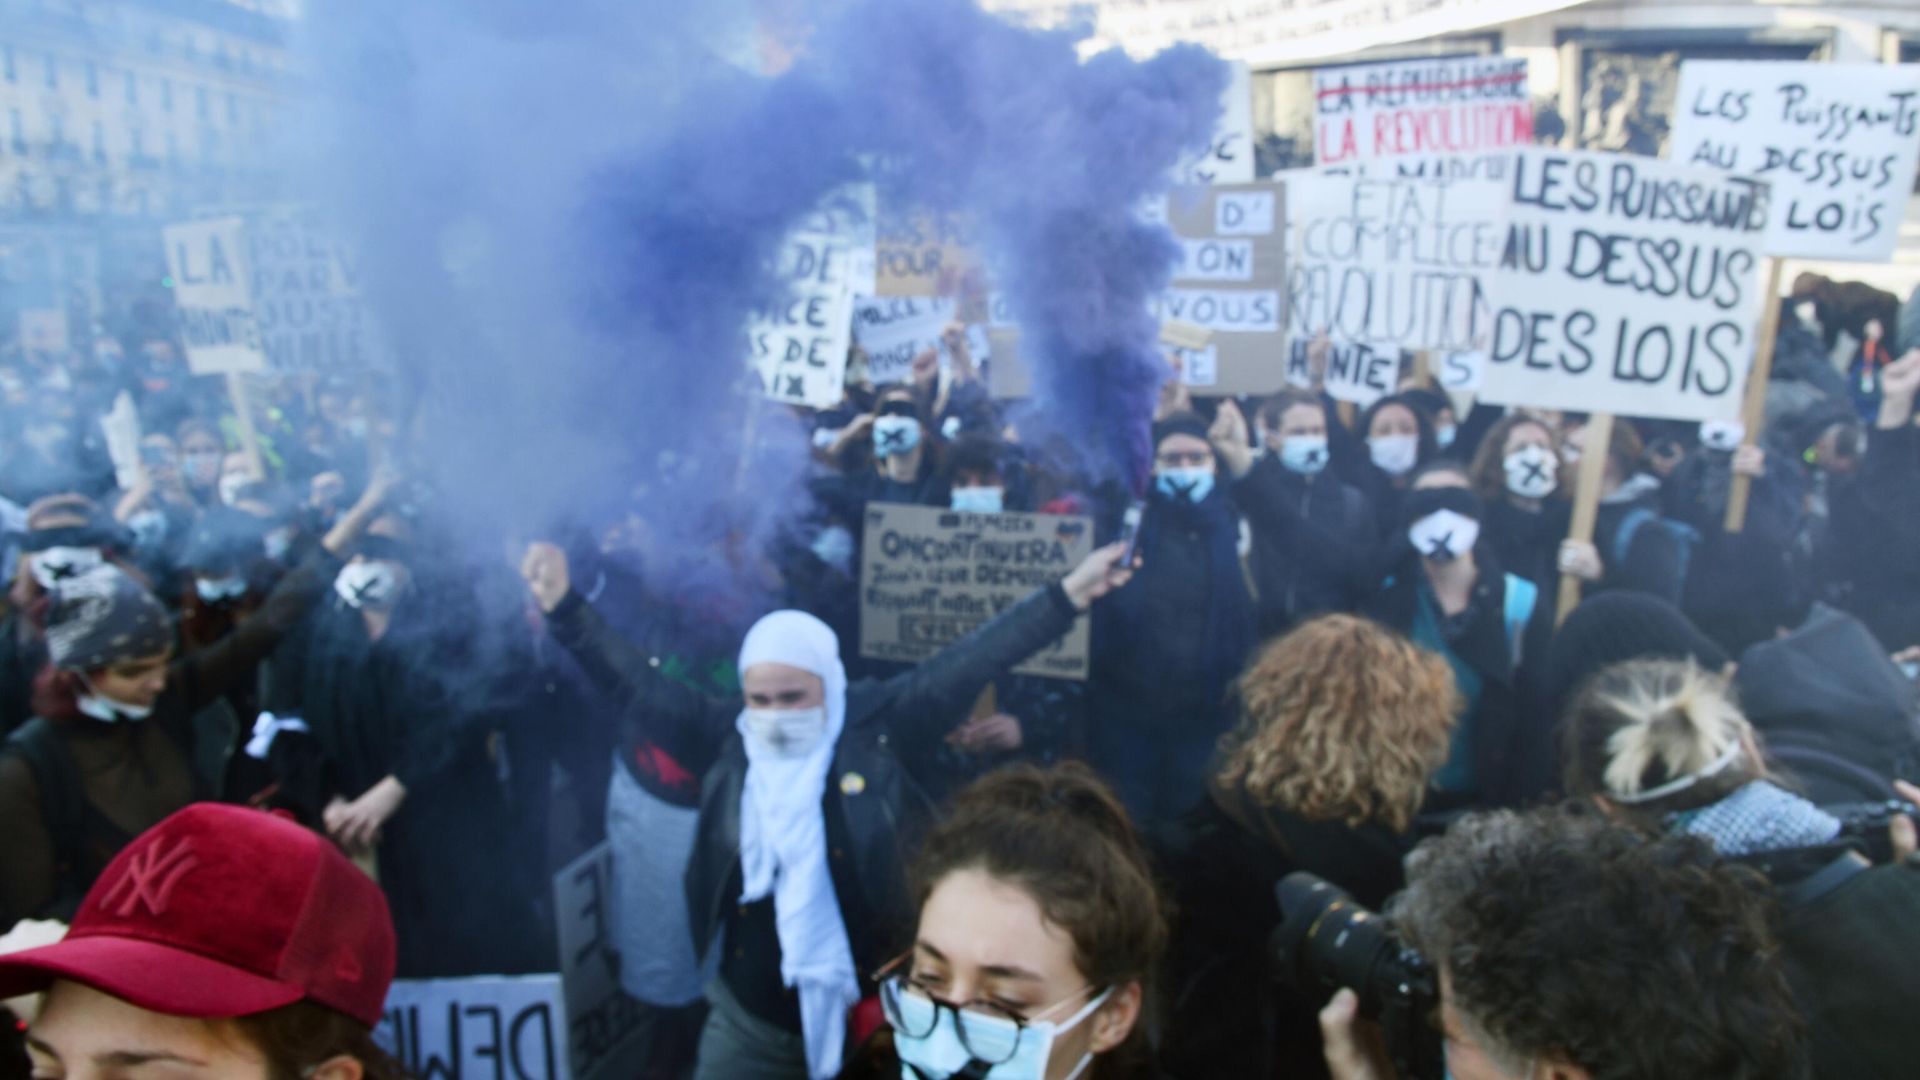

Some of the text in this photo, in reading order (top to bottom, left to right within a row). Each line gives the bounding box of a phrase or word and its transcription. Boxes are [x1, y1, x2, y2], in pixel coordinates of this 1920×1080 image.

[1316, 74, 1354, 114] LA
[1320, 117, 1357, 164] LA
[1691, 138, 1898, 190] AU DESSUS
[1513, 154, 1601, 212] LES
[176, 234, 234, 284] LA
[1500, 222, 1754, 310] AU DESSUS
[1165, 295, 1272, 325] VOUS
[785, 335, 828, 369] DE
[1490, 306, 1743, 397] DES LOIS
[99, 835, 200, 917] NY
